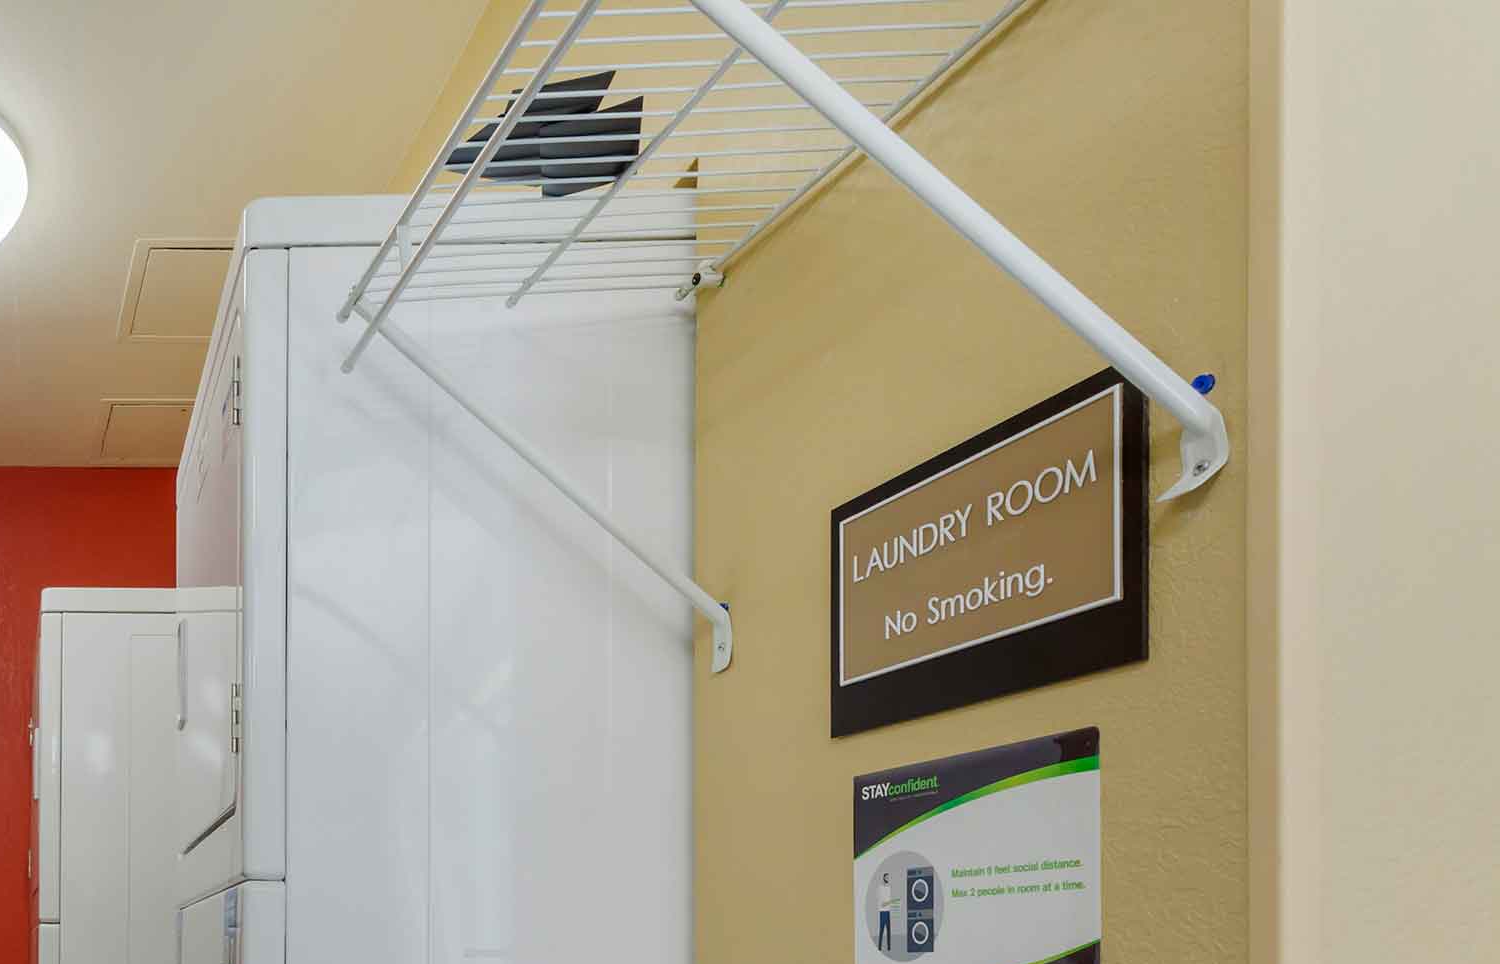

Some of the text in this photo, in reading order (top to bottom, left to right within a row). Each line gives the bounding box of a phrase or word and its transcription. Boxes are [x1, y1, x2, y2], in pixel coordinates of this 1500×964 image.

[853, 449, 1097, 583] LAUNDRY ROOM
[884, 564, 1053, 639] No Smoking.
[951, 866, 985, 878] Maintain
[994, 864, 1012, 875] feet
[1013, 862, 1039, 872] social
[951, 888, 967, 897] Max
[970, 888, 976, 896] 2
[977, 886, 1005, 898] people
[1007, 884, 1015, 893] in
[1017, 884, 1040, 893] room
[1042, 882, 1052, 892] at
[1054, 883, 1060, 891] a
